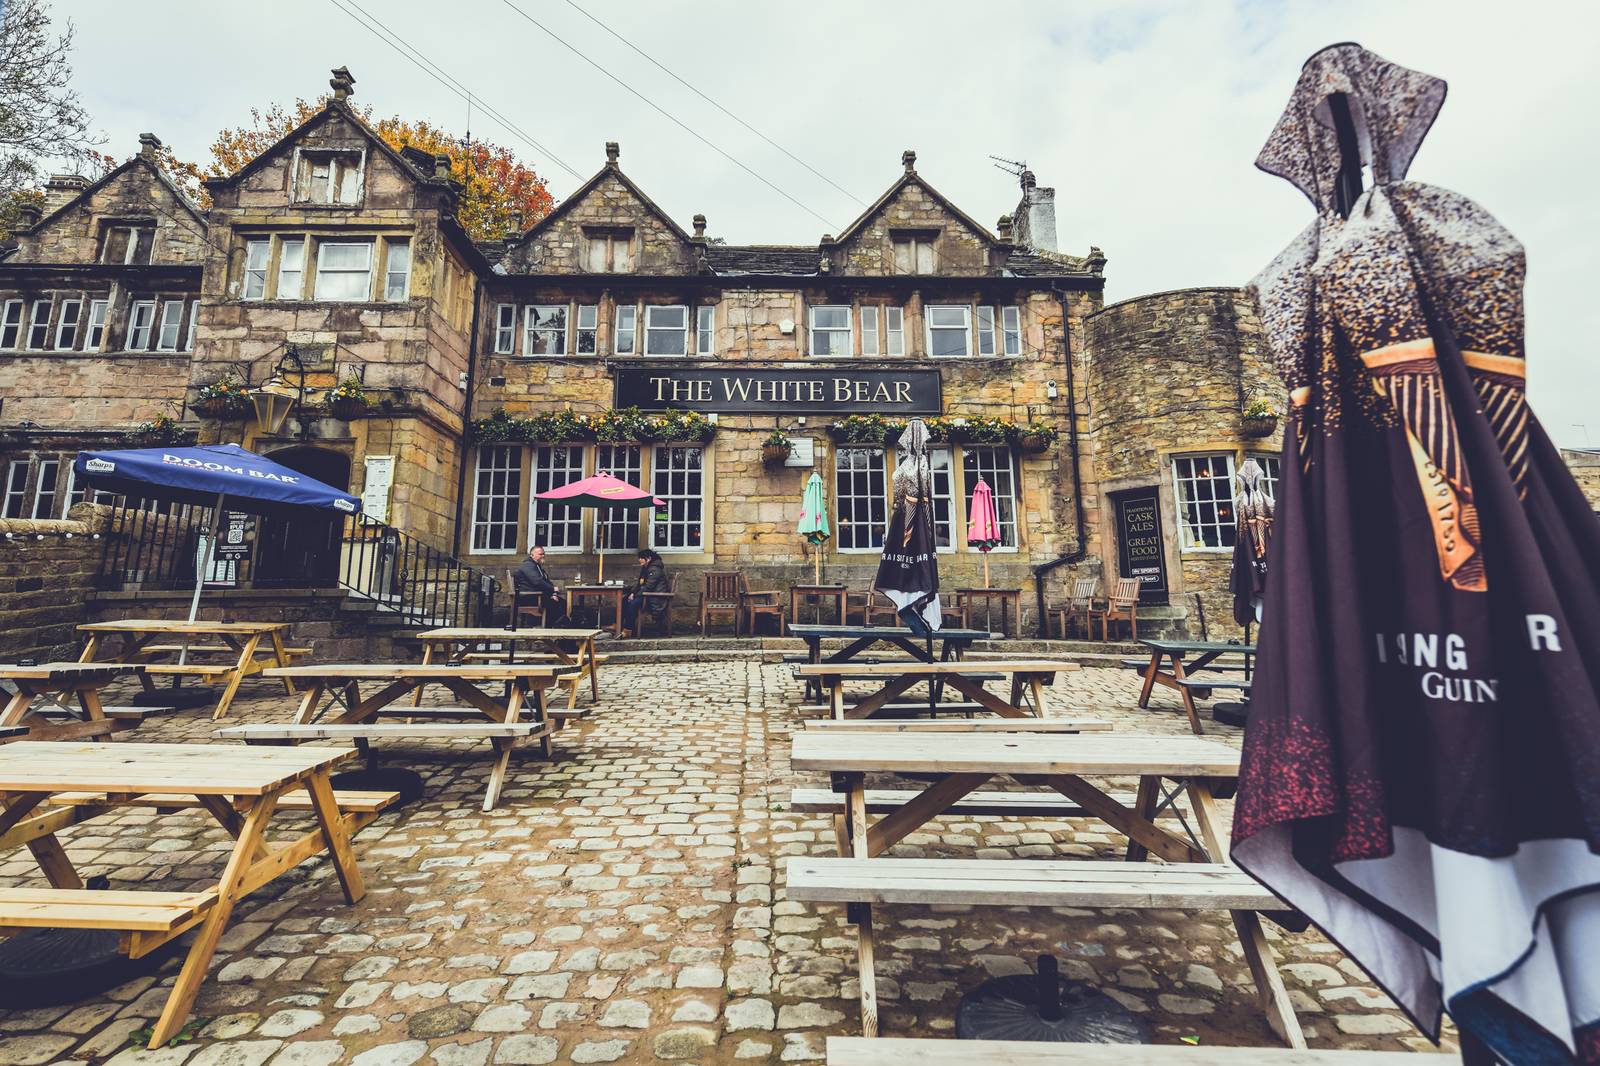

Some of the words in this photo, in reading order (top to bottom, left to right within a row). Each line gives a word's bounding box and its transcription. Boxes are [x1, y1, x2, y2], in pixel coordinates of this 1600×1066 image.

[650, 377, 713, 402] THE
[721, 377, 825, 402] WHITE
[832, 378, 913, 403] BEAR
[163, 454, 243, 475] DOOM
[249, 469, 298, 484] BAR
[1127, 512, 1154, 523] CASK
[1130, 521, 1154, 532] ALES
[1128, 537, 1157, 547] GREAT
[1131, 546, 1158, 556] FOOD
